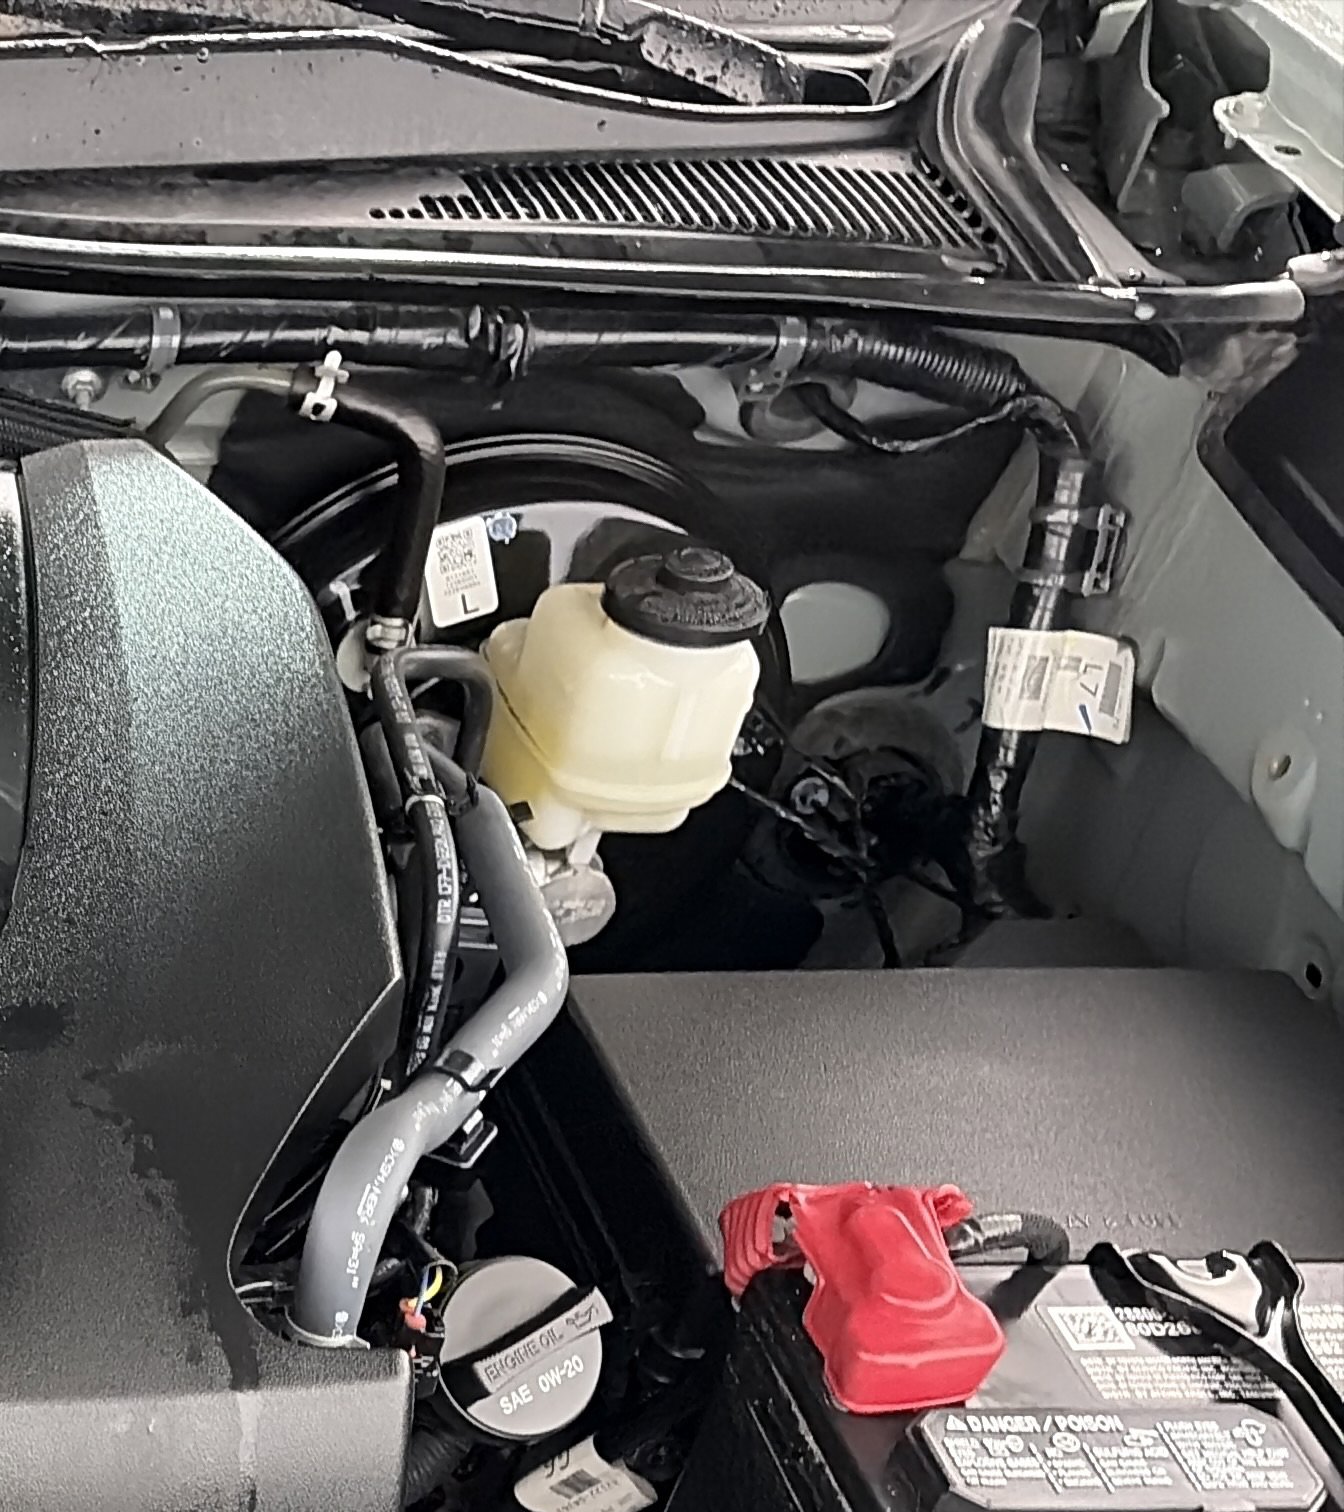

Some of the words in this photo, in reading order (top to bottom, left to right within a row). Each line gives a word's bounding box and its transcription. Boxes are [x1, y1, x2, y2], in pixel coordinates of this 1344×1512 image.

[460, 592, 480, 615] L
[483, 1335, 540, 1384] ENGINE
[539, 1326, 565, 1351] OIL
[498, 1383, 534, 1416] SAE
[537, 1354, 585, 1394] 0W-20
[966, 1414, 1041, 1433] DANGER
[1054, 1414, 1125, 1433] POISON
